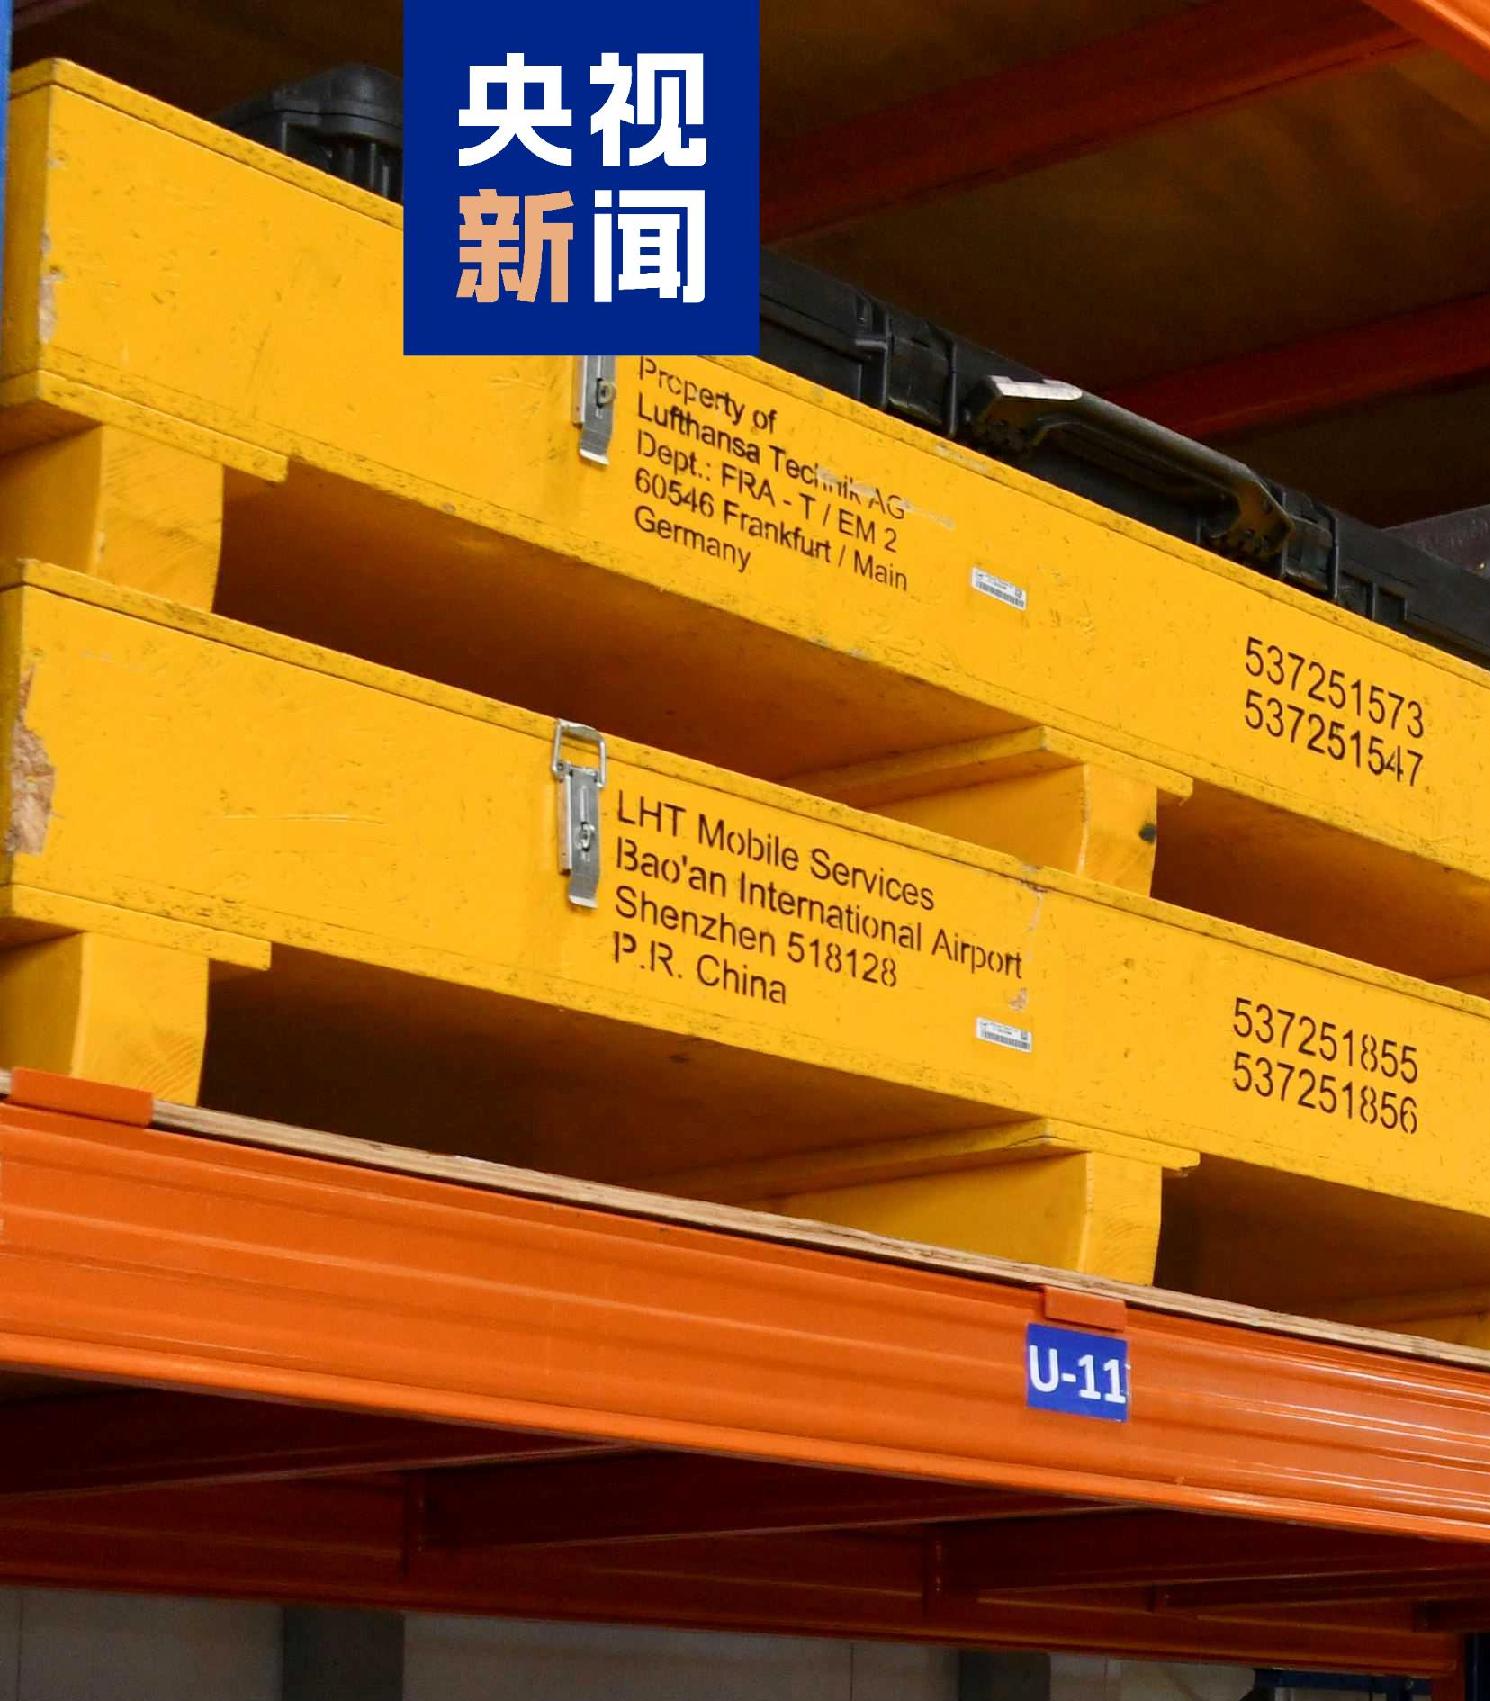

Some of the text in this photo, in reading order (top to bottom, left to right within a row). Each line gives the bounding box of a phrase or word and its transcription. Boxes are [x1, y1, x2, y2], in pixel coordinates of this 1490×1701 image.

[638, 355, 779, 434] Property of
[636, 430, 712, 482] Dept.:
[720, 467, 776, 508] FRA
[798, 492, 816, 521] T
[837, 511, 876, 546] EM
[884, 527, 898, 553] 2
[637, 391, 760, 465] Lufthansa
[868, 486, 906, 520] AG
[633, 504, 751, 573] Germany
[634, 468, 715, 518] 60546
[722, 500, 831, 564] Frankfurt
[853, 550, 909, 592] Main
[1243, 688, 1425, 790] 537251547
[1244, 635, 1426, 740] 537251573
[615, 789, 935, 913] LHT Mobile Services
[614, 836, 1023, 980] Bao'an International Airport
[614, 885, 898, 989] Shenzhen 518128
[612, 929, 788, 1005] P.R. China
[1233, 997, 1419, 1084] 537251855
[1233, 1051, 1419, 1135] 537251856
[1028, 1344, 1127, 1404] U-11
